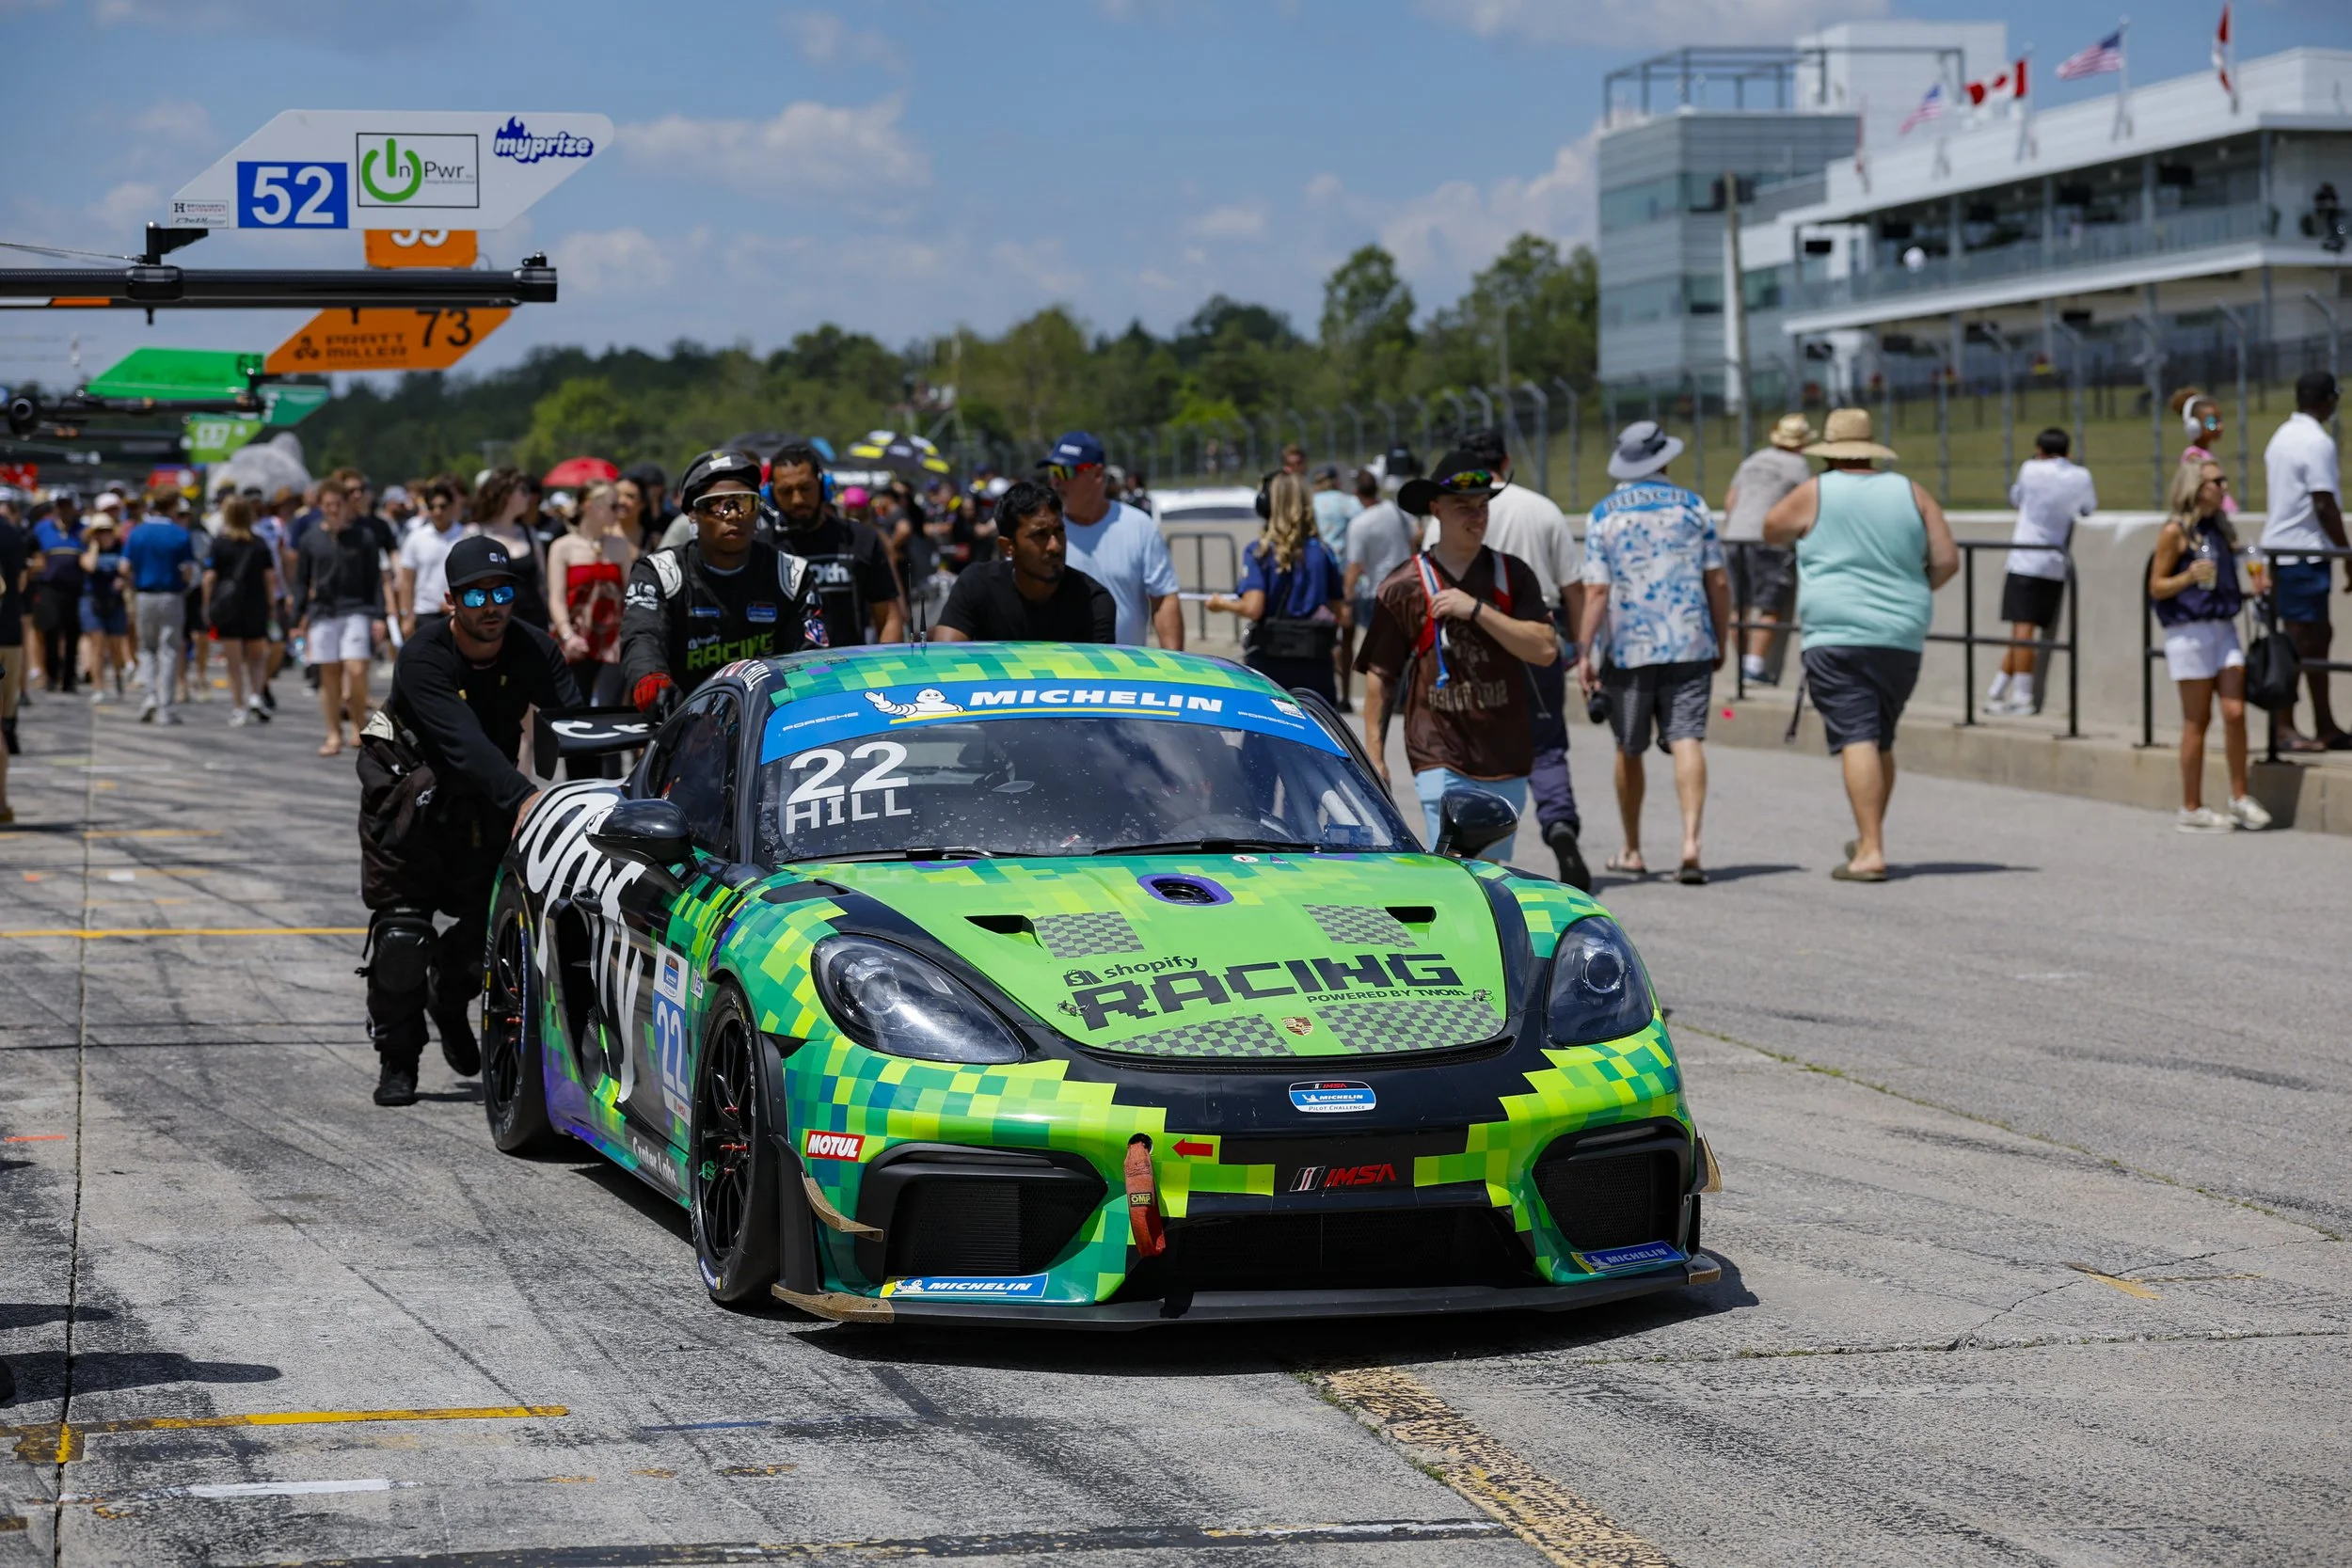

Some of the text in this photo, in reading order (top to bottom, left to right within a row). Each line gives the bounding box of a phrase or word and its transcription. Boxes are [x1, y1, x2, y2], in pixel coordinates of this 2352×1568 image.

[494, 131, 594, 163] myprize
[424, 161, 465, 178] Pwr
[251, 166, 334, 225] 52
[416, 308, 472, 348] 73
[969, 689, 1223, 713] MICHELIN
[782, 711, 860, 732] PORSCHE
[1237, 711, 1305, 730] PORSCHE
[787, 741, 909, 805] 22
[786, 789, 912, 835] HILL
[1104, 956, 1198, 979] shopify
[1306, 990, 1388, 1003] POWERED
[1389, 990, 1411, 998] BY
[656, 1000, 690, 1101] 22
[807, 1132, 861, 1158] MOTUL
[1324, 1164, 1397, 1188] IMSA
[1131, 1196, 1151, 1204] OMP
[1605, 1248, 1668, 1263] MICHELIN
[929, 1281, 1034, 1291] MICHELIN
